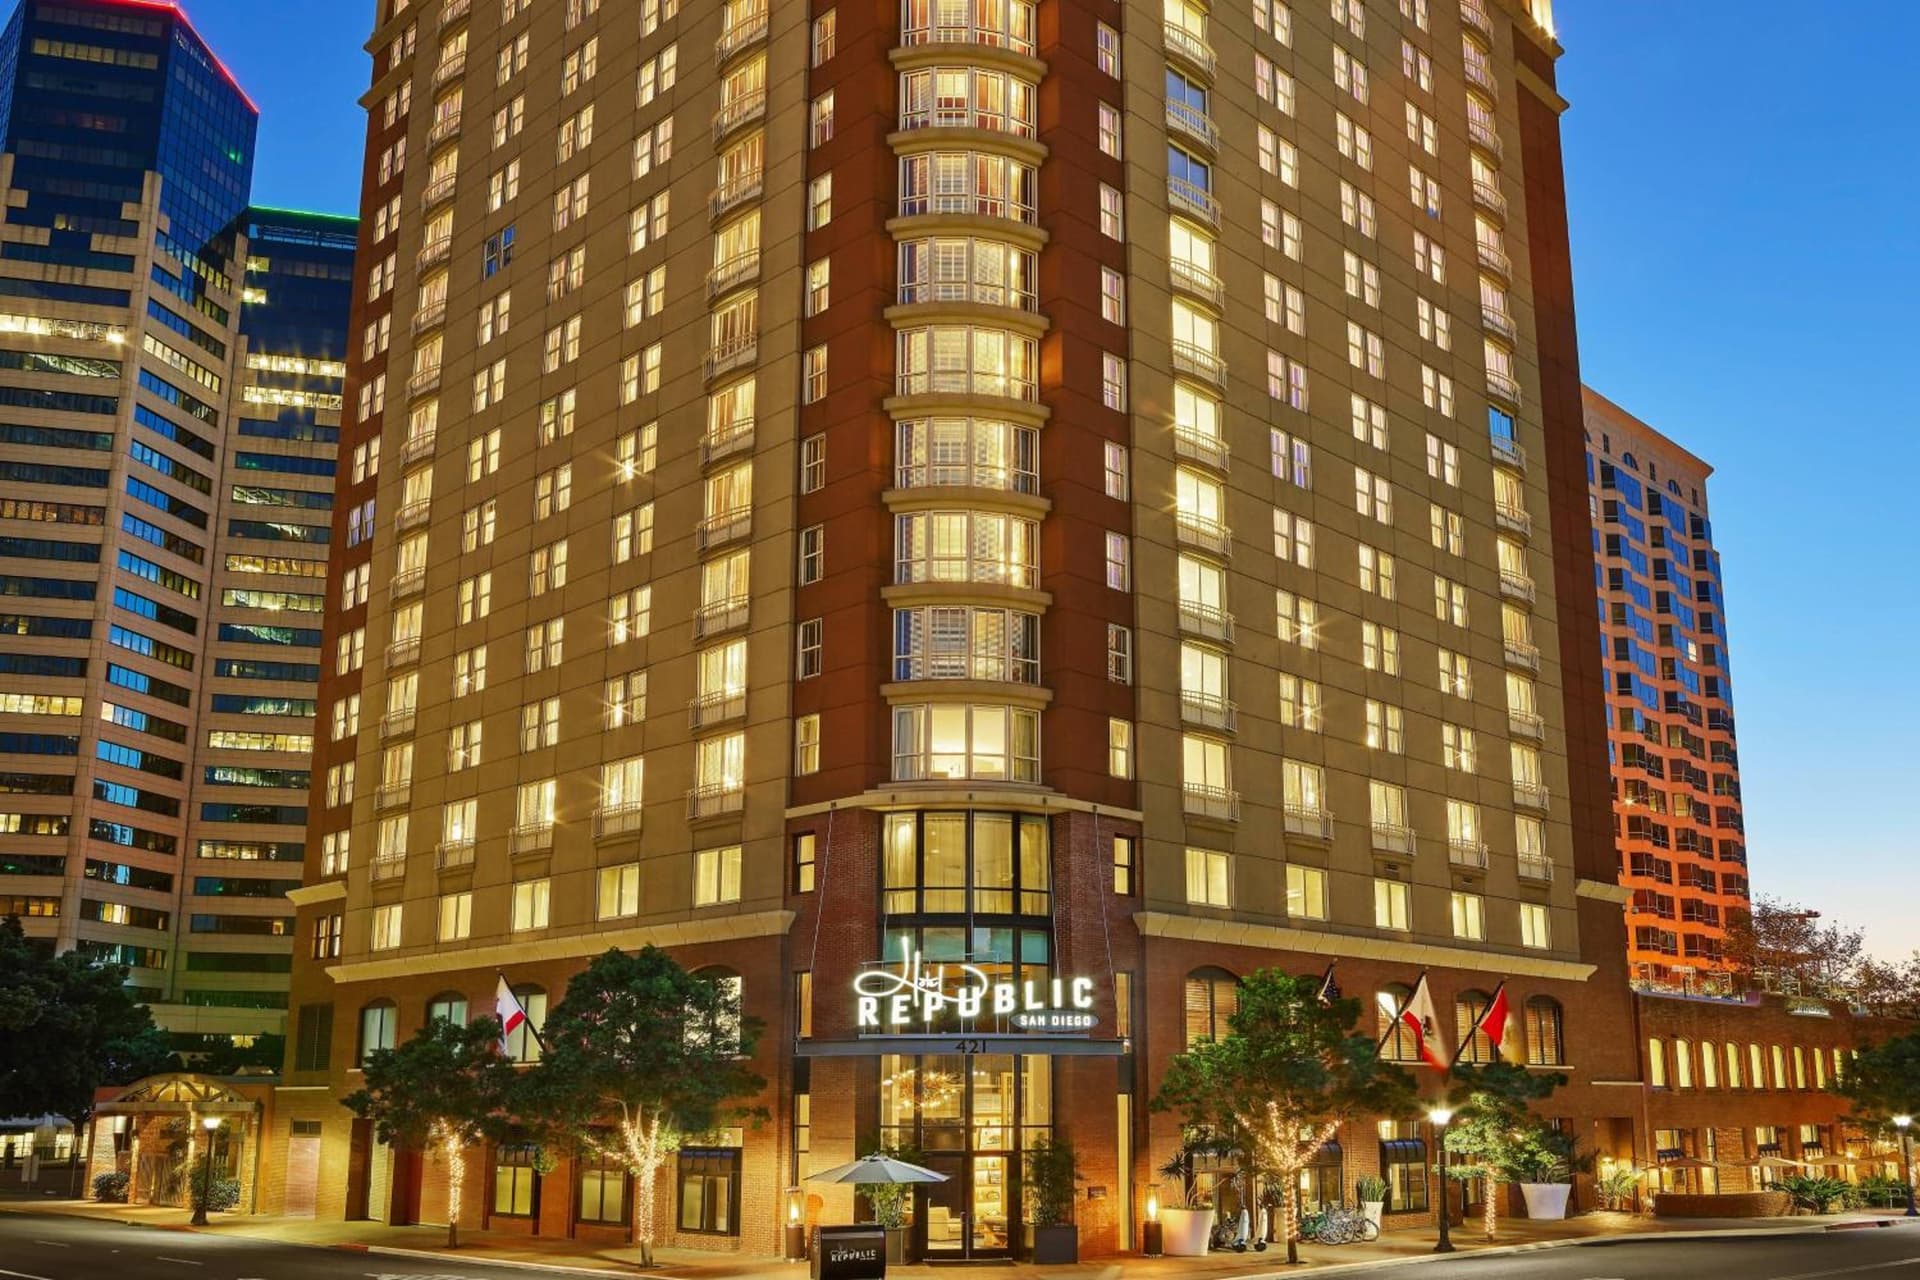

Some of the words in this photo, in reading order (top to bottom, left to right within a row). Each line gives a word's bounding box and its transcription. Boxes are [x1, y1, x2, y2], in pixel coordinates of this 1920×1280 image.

[853, 935, 988, 1008] Hotel
[858, 976, 1094, 1026] REPUBLIC
[1020, 1014, 1046, 1026] SAN
[1051, 1014, 1092, 1026] DIEGO
[955, 1039, 986, 1053] 421
